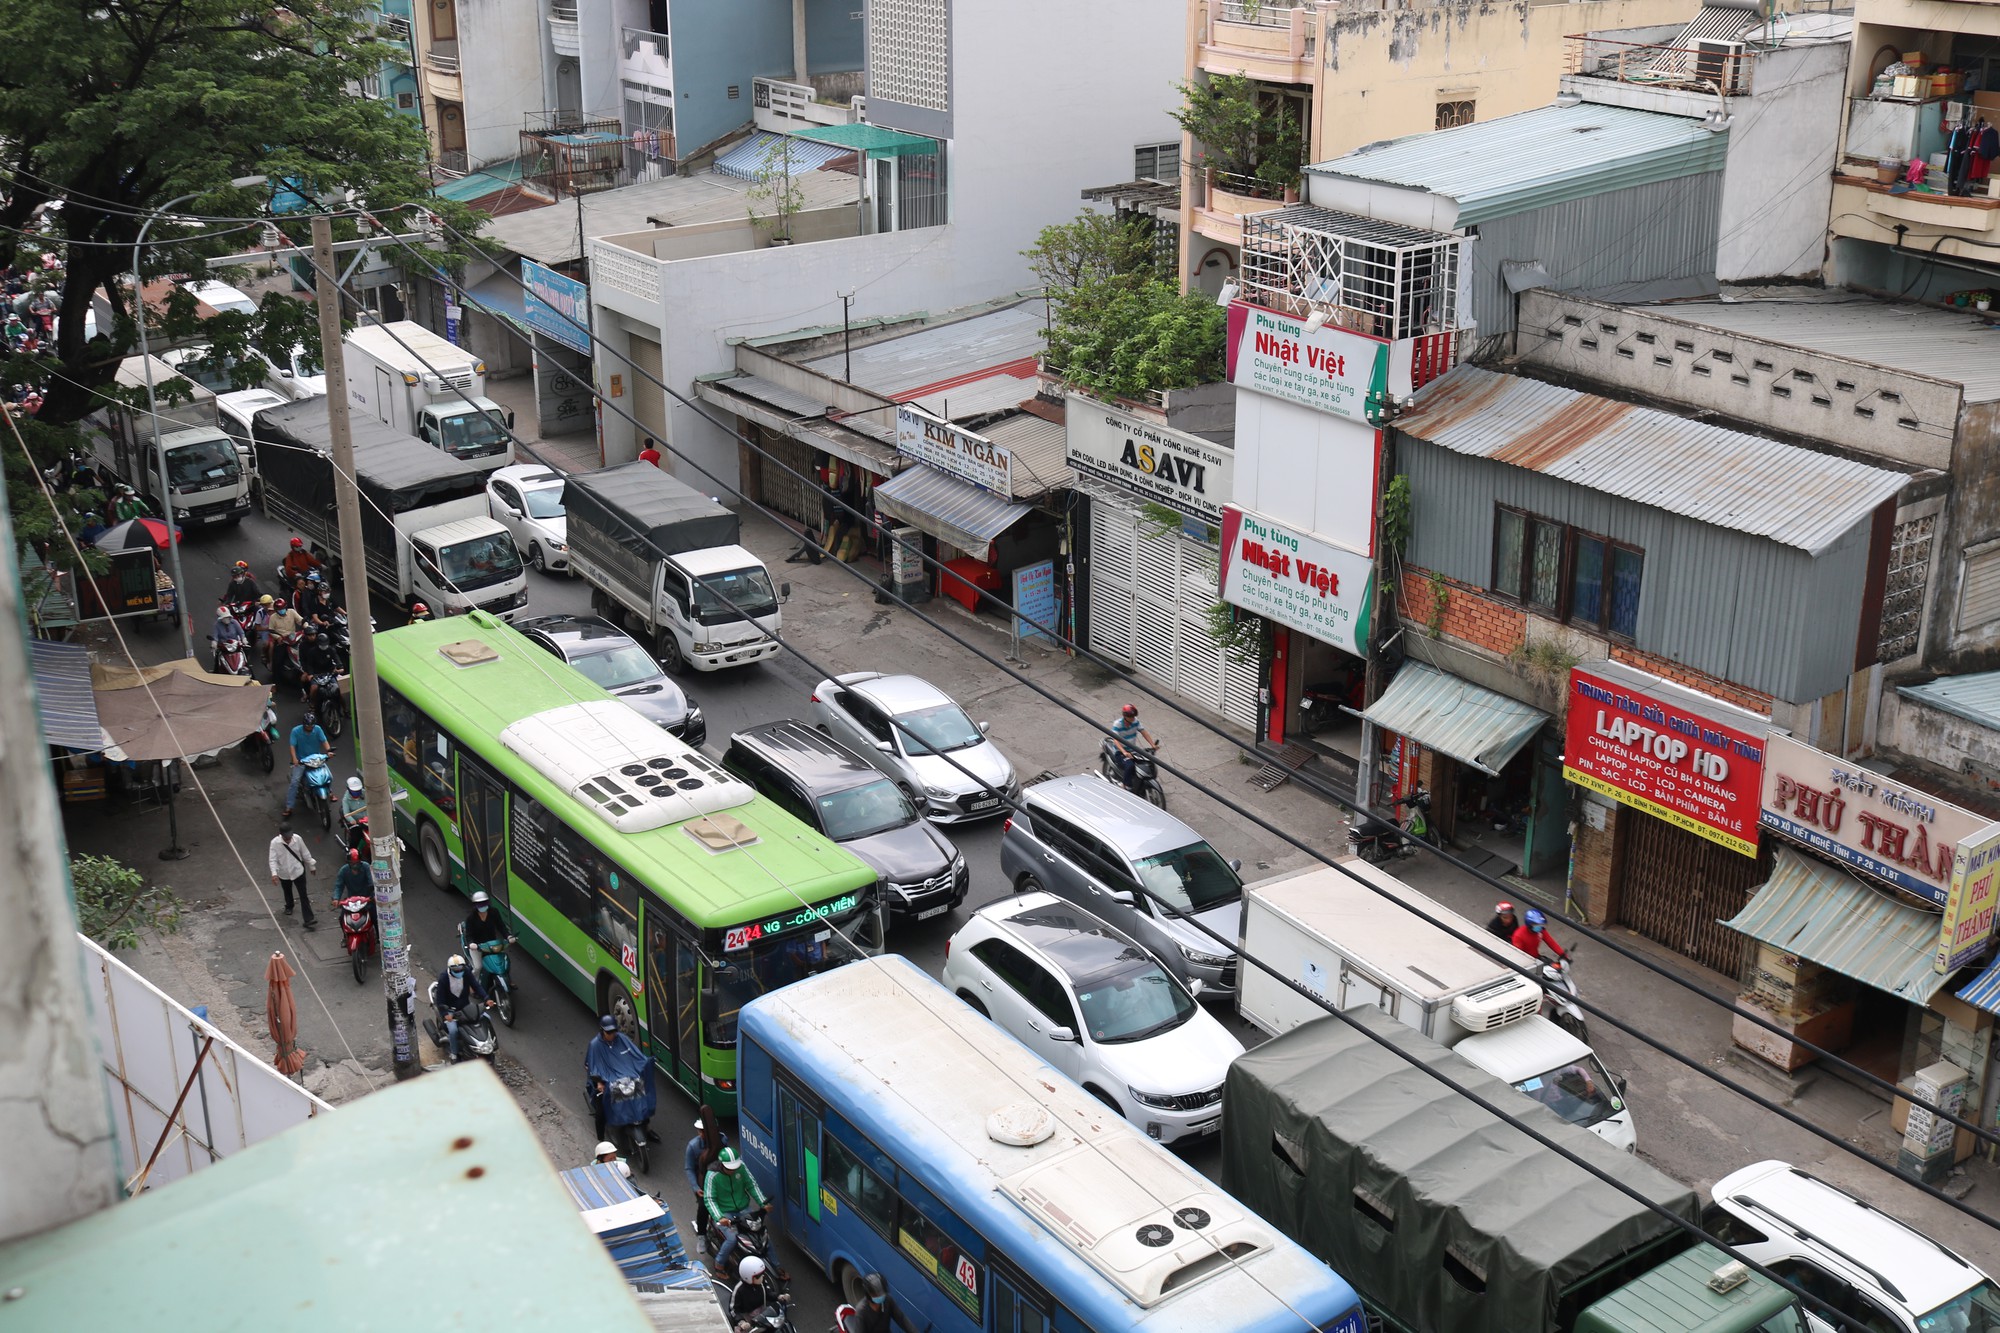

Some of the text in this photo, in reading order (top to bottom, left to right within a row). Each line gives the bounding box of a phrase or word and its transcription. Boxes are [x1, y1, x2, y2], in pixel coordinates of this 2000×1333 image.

[1257, 314, 1300, 337] Phụ tùng
[1254, 358, 1354, 396] Chuyên cung cấp phụ tùng
[1256, 332, 1345, 379] Nhật Việt
[1254, 370, 1266, 381] các
[1269, 373, 1282, 386] loại
[1295, 382, 1305, 393] tay
[1307, 386, 1318, 398] ga,
[1321, 391, 1329, 399] xe
[1331, 392, 1341, 403] số
[924, 421, 1007, 471] KIM NGÂN
[1105, 417, 1221, 466] CÔNG TY CỔ PHẦN CÔNG NGHỆ ASAVI
[1083, 454, 1095, 464] COOL
[1097, 459, 1106, 468] LED
[1120, 469, 1132, 479] DỤNG
[1139, 476, 1153, 487] CÔNG
[1155, 482, 1174, 496] NGHIỆP
[1179, 491, 1191, 502] DỊCH
[1194, 497, 1201, 506] VỤ
[1203, 501, 1216, 512] CUNG
[1120, 439, 1205, 494] ASAVI
[1244, 518, 1298, 552] Phụ tùng
[1242, 539, 1339, 598] Nhật Việt
[1243, 568, 1348, 621] Chuyên cung cấp phụ tùng
[1243, 584, 1335, 627] các loại xe tay ga, xe số
[1577, 680, 1761, 763] TRUNG TÂM SỬA CHỮA MÁY TÍNH
[1596, 710, 1729, 782] LAPTOP HD
[1579, 758, 1593, 769] PIN
[1601, 767, 1620, 781] SẠC
[1628, 779, 1646, 791] LCD
[1655, 786, 1674, 803] BÀN
[1676, 798, 1699, 814] PHÍM
[1708, 809, 1728, 826] BẢN
[1588, 736, 1736, 801] CHUYÊN LAPTOP CŨ BH 6 THÁNG
[1596, 752, 1726, 812] LAPTOP PC LCD CAMERA
[1579, 775, 1589, 783] 477
[1591, 780, 1606, 792] XVNT,
[1615, 790, 1622, 799] 26
[1627, 795, 1633, 803] Q.
[1634, 798, 1647, 809] BÌNH
[1649, 804, 1667, 817] THẠNH
[1673, 814, 1695, 829] TP.HCM
[1697, 825, 1708, 834] ĐT:
[1709, 829, 1724, 840] 0974
[1726, 835, 1737, 846] 212
[1739, 842, 1750, 852] 652
[1772, 773, 1846, 833] PHÚ
[1880, 789, 1934, 823] KÍNH
[1762, 812, 1779, 828] 479
[1781, 820, 1790, 831] XÔ
[1793, 827, 1808, 840] VIẾT
[1810, 834, 1831, 851] NGHỆ
[1857, 857, 1874, 870] P.26
[1881, 867, 1899, 881] Q.BT
[1970, 867, 1994, 904] PHÚ
[727, 931, 745, 948] 24
[744, 924, 762, 941] 24
[830, 896, 855, 913] VIÊN
[1956, 906, 1993, 945] THÀNH
[624, 946, 635, 971] 24
[960, 1261, 974, 1289] 43
